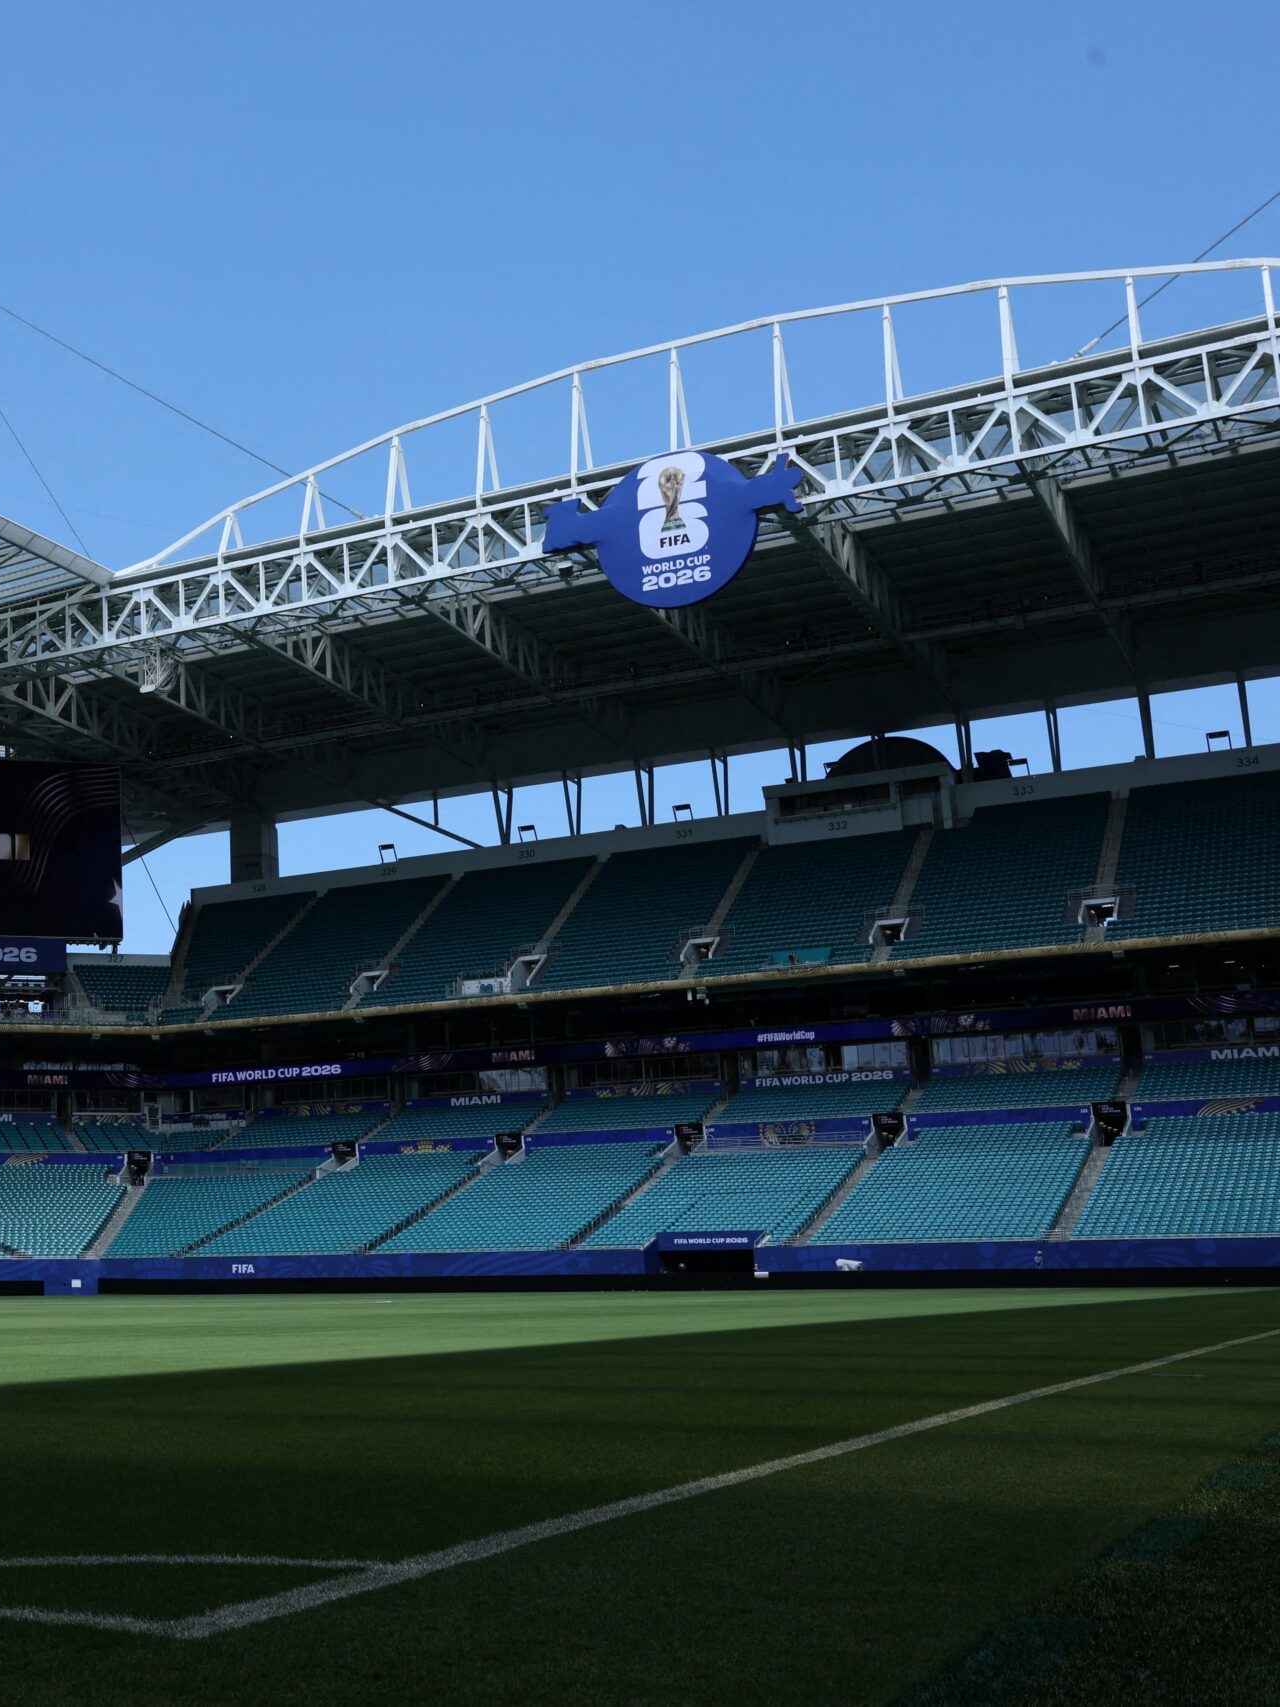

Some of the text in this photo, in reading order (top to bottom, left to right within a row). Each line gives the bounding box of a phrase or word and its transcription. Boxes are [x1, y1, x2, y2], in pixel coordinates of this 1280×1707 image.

[660, 533, 690, 548] FIFA
[641, 554, 711, 576] WORLD CUP
[642, 566, 712, 592] 2026
[1236, 755, 1260, 768] 334
[1012, 785, 1034, 796] 333
[828, 820, 848, 832] 332
[676, 829, 693, 839] 331
[519, 849, 535, 859] 330
[1072, 1004, 1132, 1021] MIAMI
[757, 1031, 815, 1043] #FIFAWorldCup
[491, 1050, 535, 1063] MIAMI
[26, 1074, 68, 1086] MIAMI
[211, 1064, 342, 1083] FIFA WORLD CUP 2026
[755, 1077, 780, 1088] FIFA
[782, 1075, 823, 1086] WORLD
[825, 1073, 850, 1084] CUP
[851, 1070, 894, 1082] 2026
[450, 1094, 501, 1107] MIAMI
[231, 1264, 255, 1274] FIFA
